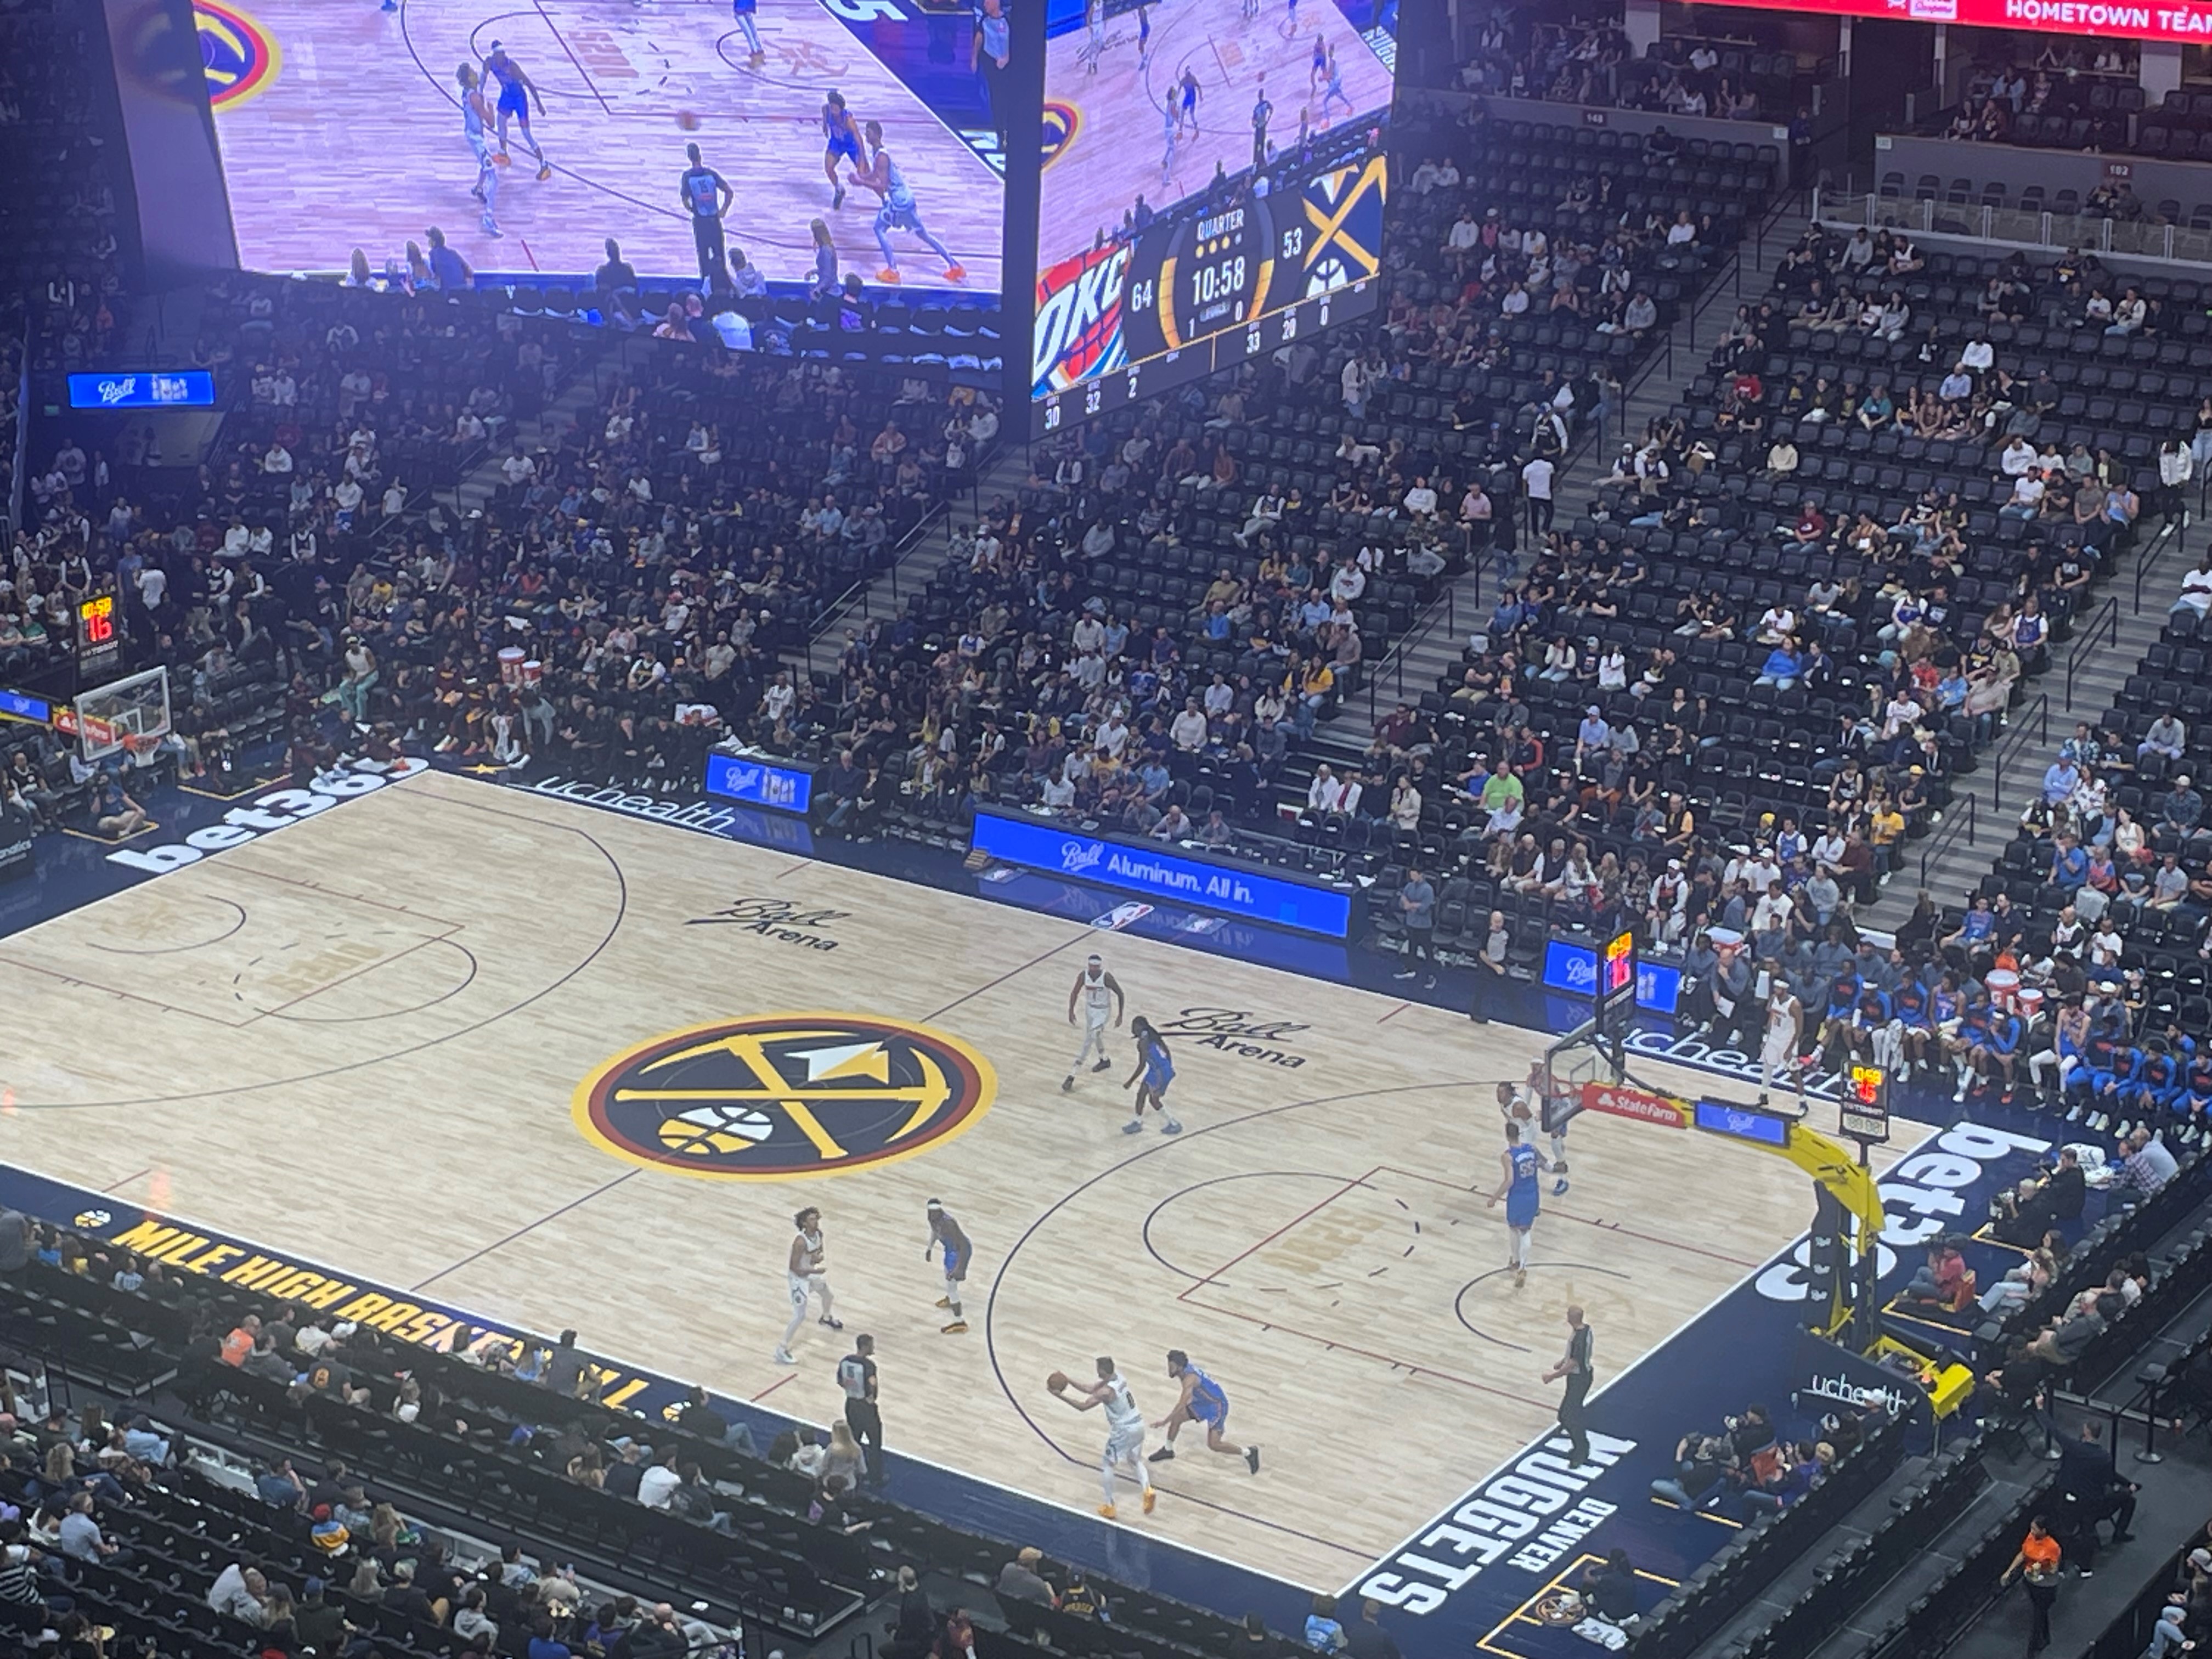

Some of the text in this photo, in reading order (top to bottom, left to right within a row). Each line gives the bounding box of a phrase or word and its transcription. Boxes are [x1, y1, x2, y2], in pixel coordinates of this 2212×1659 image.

[2007, 0, 2151, 29] HOMETOWN
[1197, 208, 1244, 241] QUARTER
[1282, 228, 1302, 259] 53
[1192, 255, 1245, 306] 10:58
[1132, 279, 1153, 313] 64
[1031, 246, 1129, 386] OKC
[1235, 301, 1243, 321] 0
[1319, 305, 1328, 326] 0
[1188, 317, 1195, 338] 1
[1282, 317, 1296, 341] 20
[1246, 331, 1260, 354] 33
[98, 377, 136, 404] Ball
[1086, 391, 1101, 414] 32
[1128, 377, 1137, 399] 2
[1045, 406, 1060, 430] 30
[88, 616, 112, 642] 16
[726, 766, 759, 792] Ball
[105, 757, 430, 873] bet365
[534, 776, 736, 837] uchealth
[0, 839, 31, 859] anatics
[1061, 841, 1254, 904] Ball Aluminum. All in.
[683, 898, 853, 928] Ball
[741, 922, 838, 951] Arena
[1566, 957, 1597, 985] Ba
[1159, 1007, 1311, 1043] Ball
[1194, 1034, 1306, 1069] Arena
[111, 1220, 246, 1274] MILE
[220, 1255, 357, 1309] HIGH
[1812, 1373, 1908, 1417] uchelth
[1359, 1429, 1638, 1615] NUGGETS
[1506, 1496, 1618, 1573] DENVER
